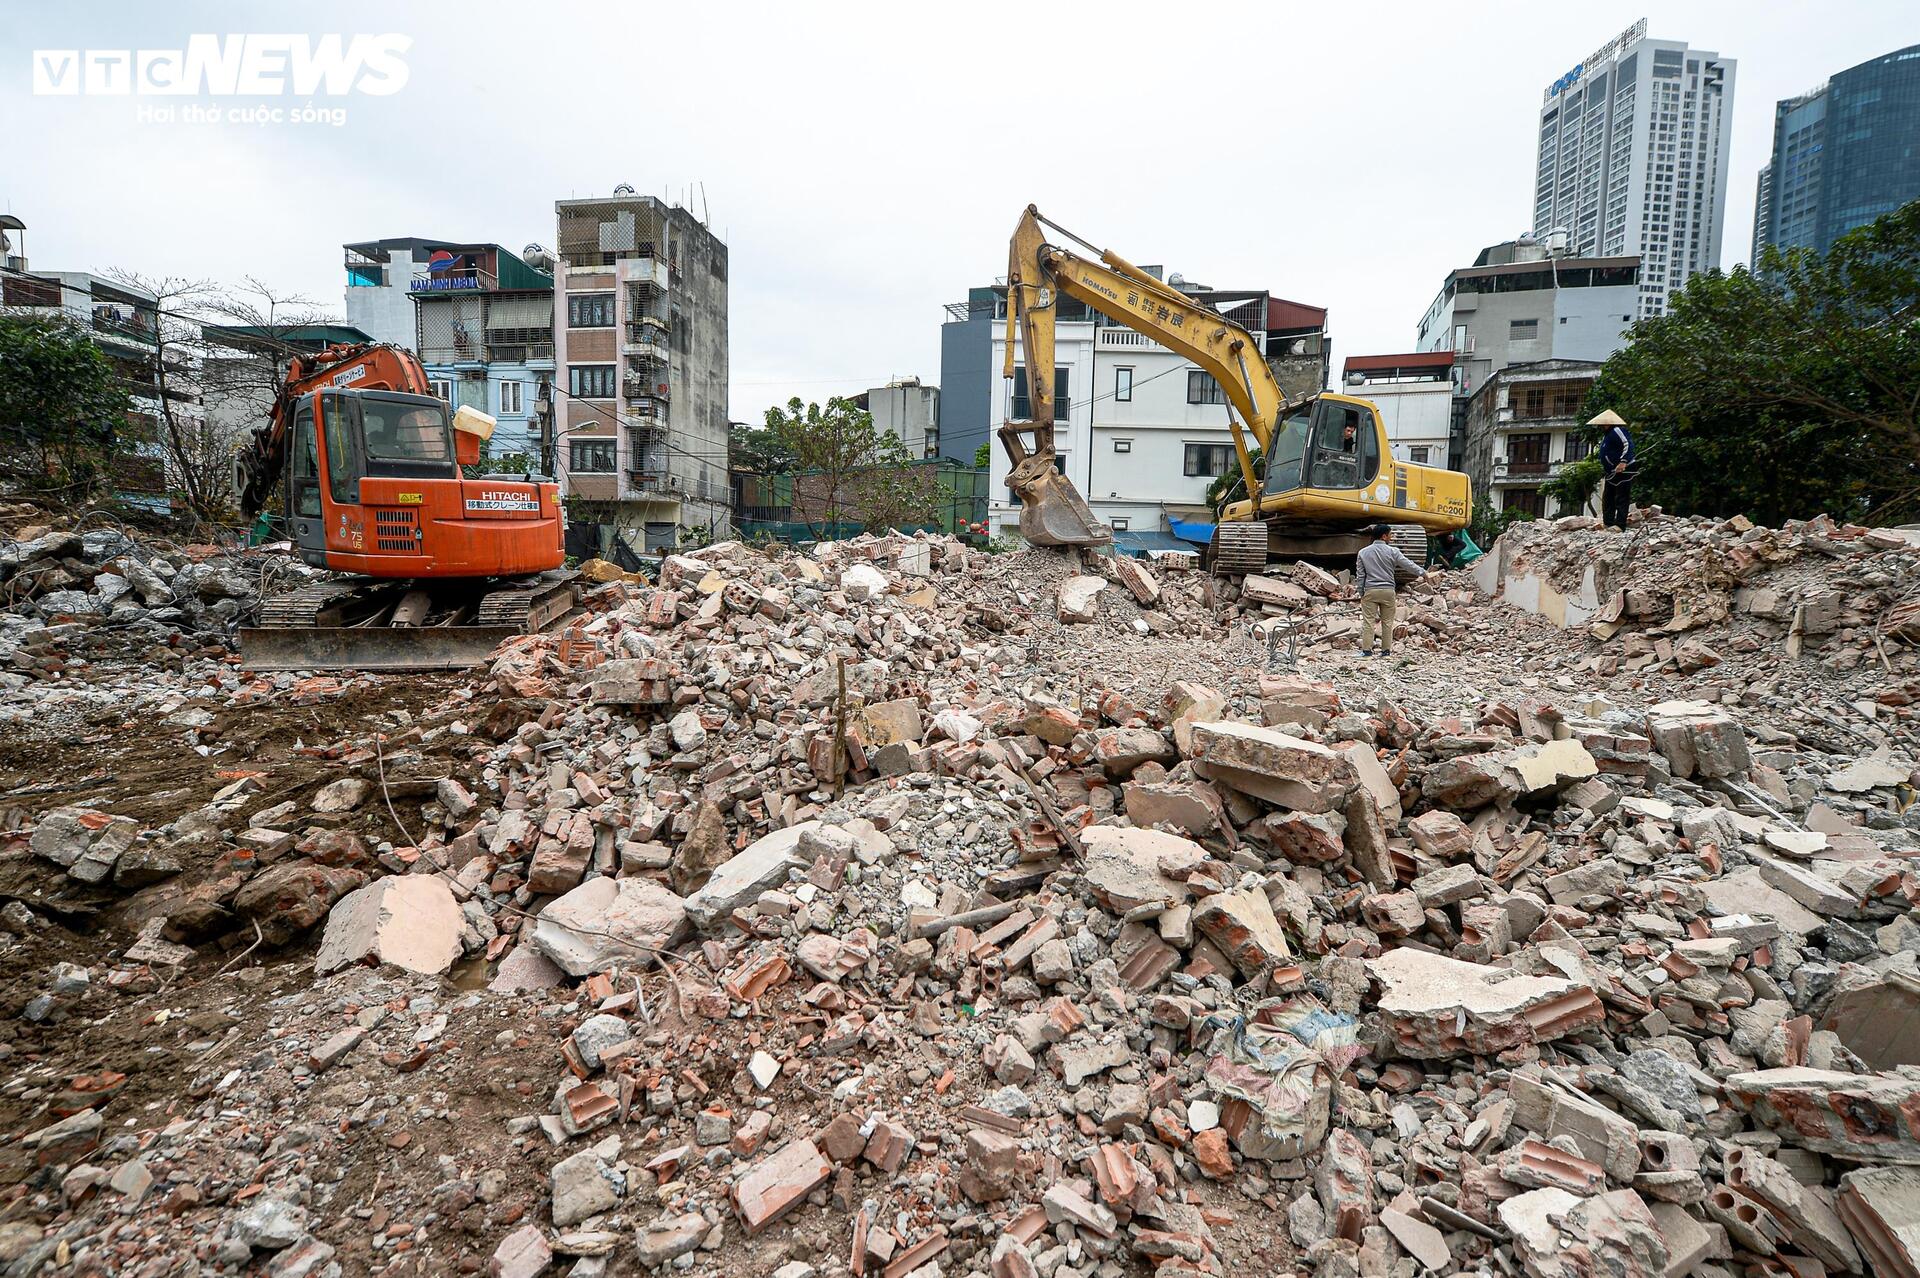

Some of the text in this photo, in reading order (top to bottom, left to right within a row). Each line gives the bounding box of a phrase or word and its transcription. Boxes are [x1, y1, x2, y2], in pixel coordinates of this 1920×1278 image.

[411, 279, 430, 291] NAM
[1082, 276, 1118, 300] KOMATSU
[482, 491, 531, 501] HITACHI
[1437, 503, 1464, 516] PC200
[351, 531, 363, 541] 75
[352, 541, 362, 549] US
